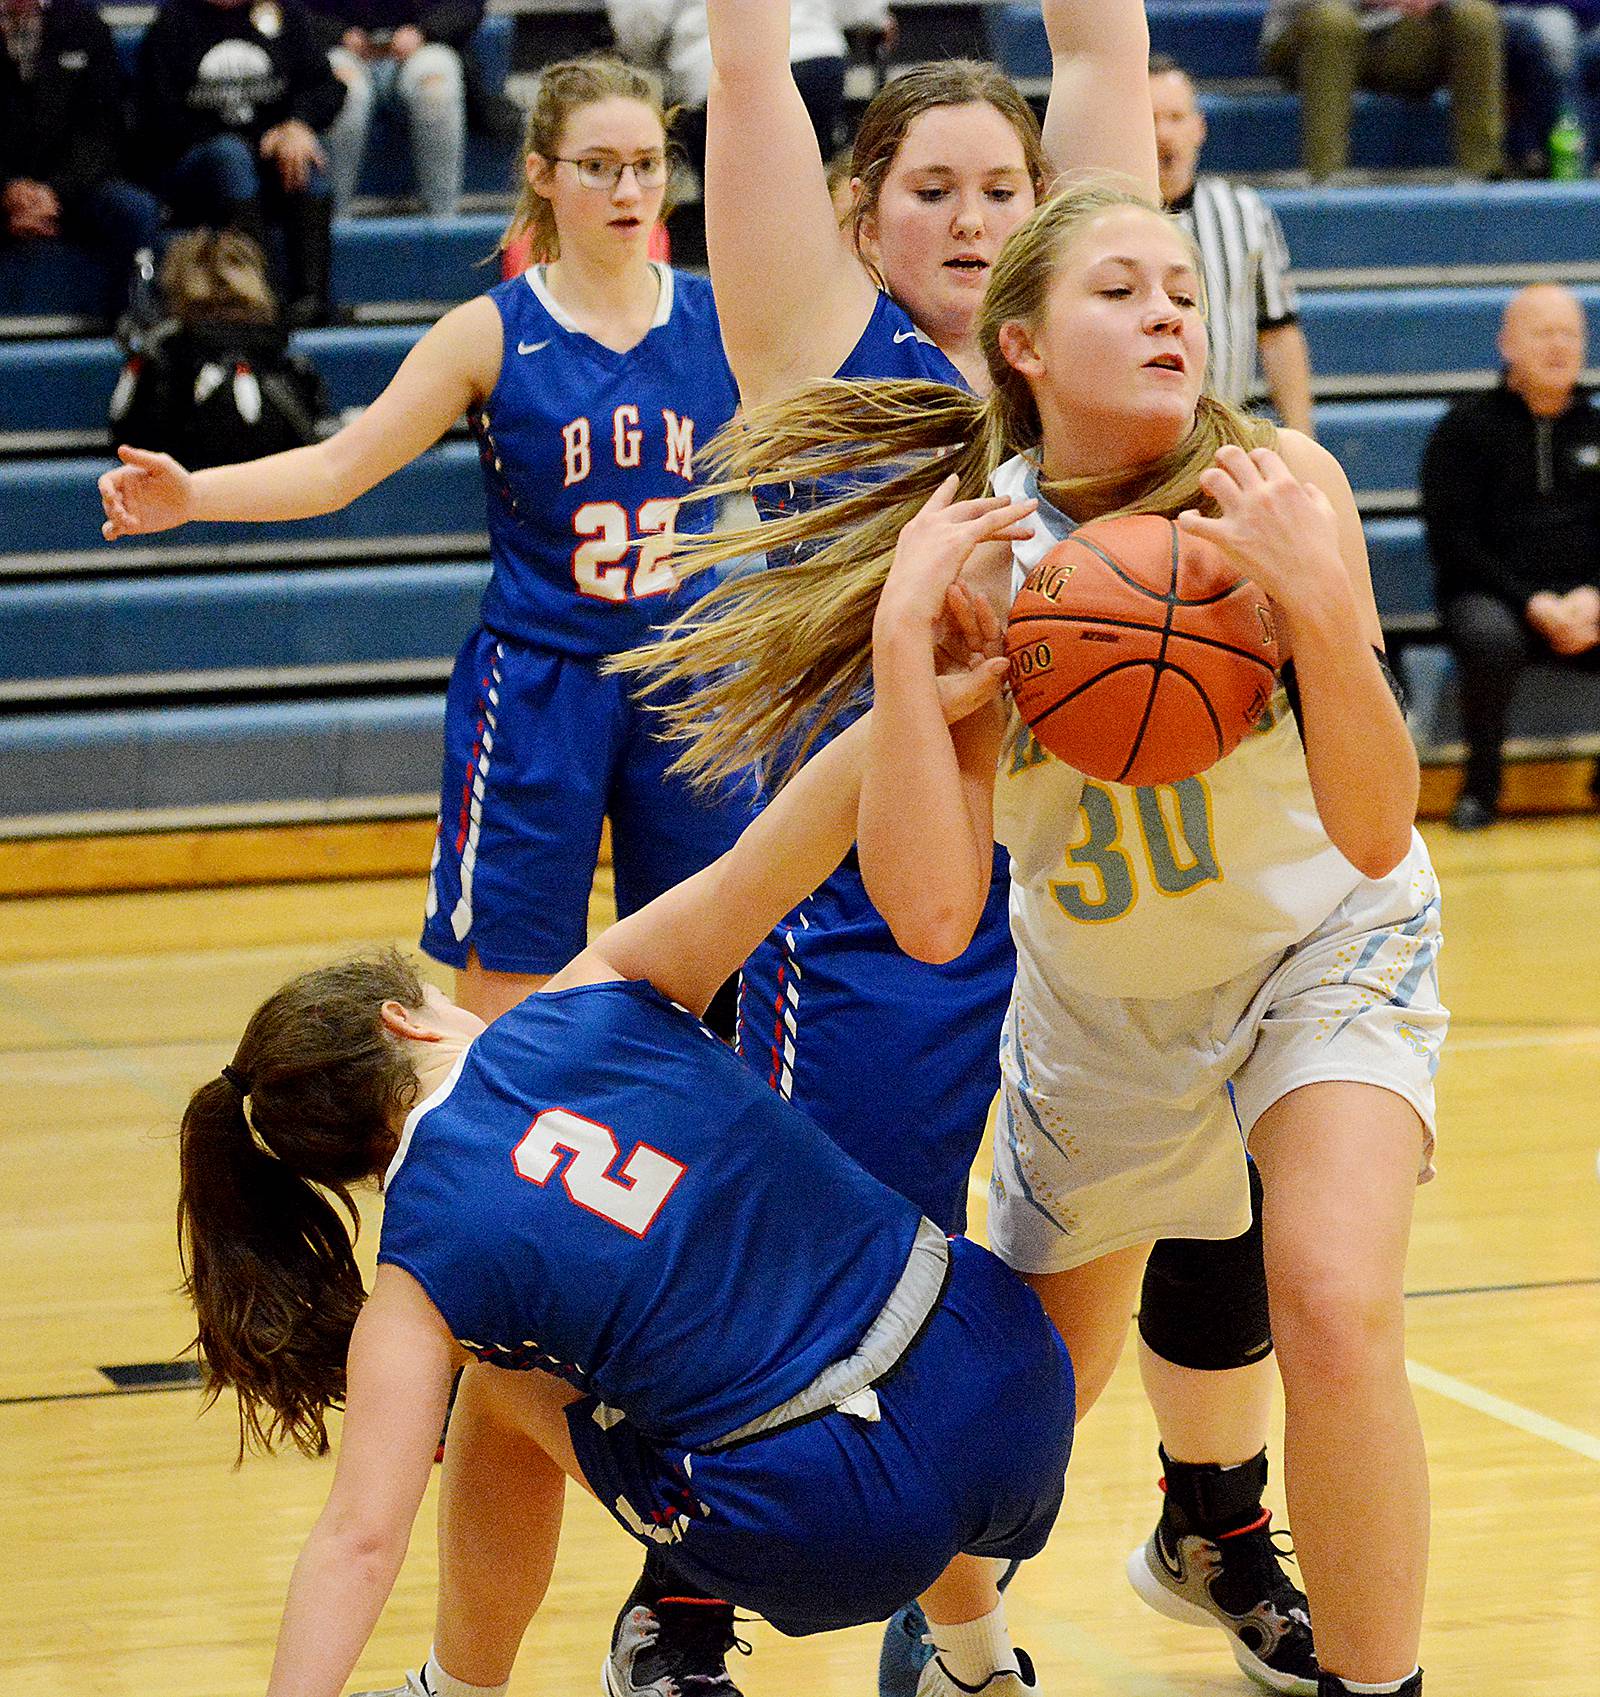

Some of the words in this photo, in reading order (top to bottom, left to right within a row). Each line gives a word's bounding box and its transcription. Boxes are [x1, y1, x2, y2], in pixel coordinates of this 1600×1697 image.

[571, 497, 682, 604] 22
[1048, 773, 1224, 925] 30
[510, 1107, 689, 1240] 2
